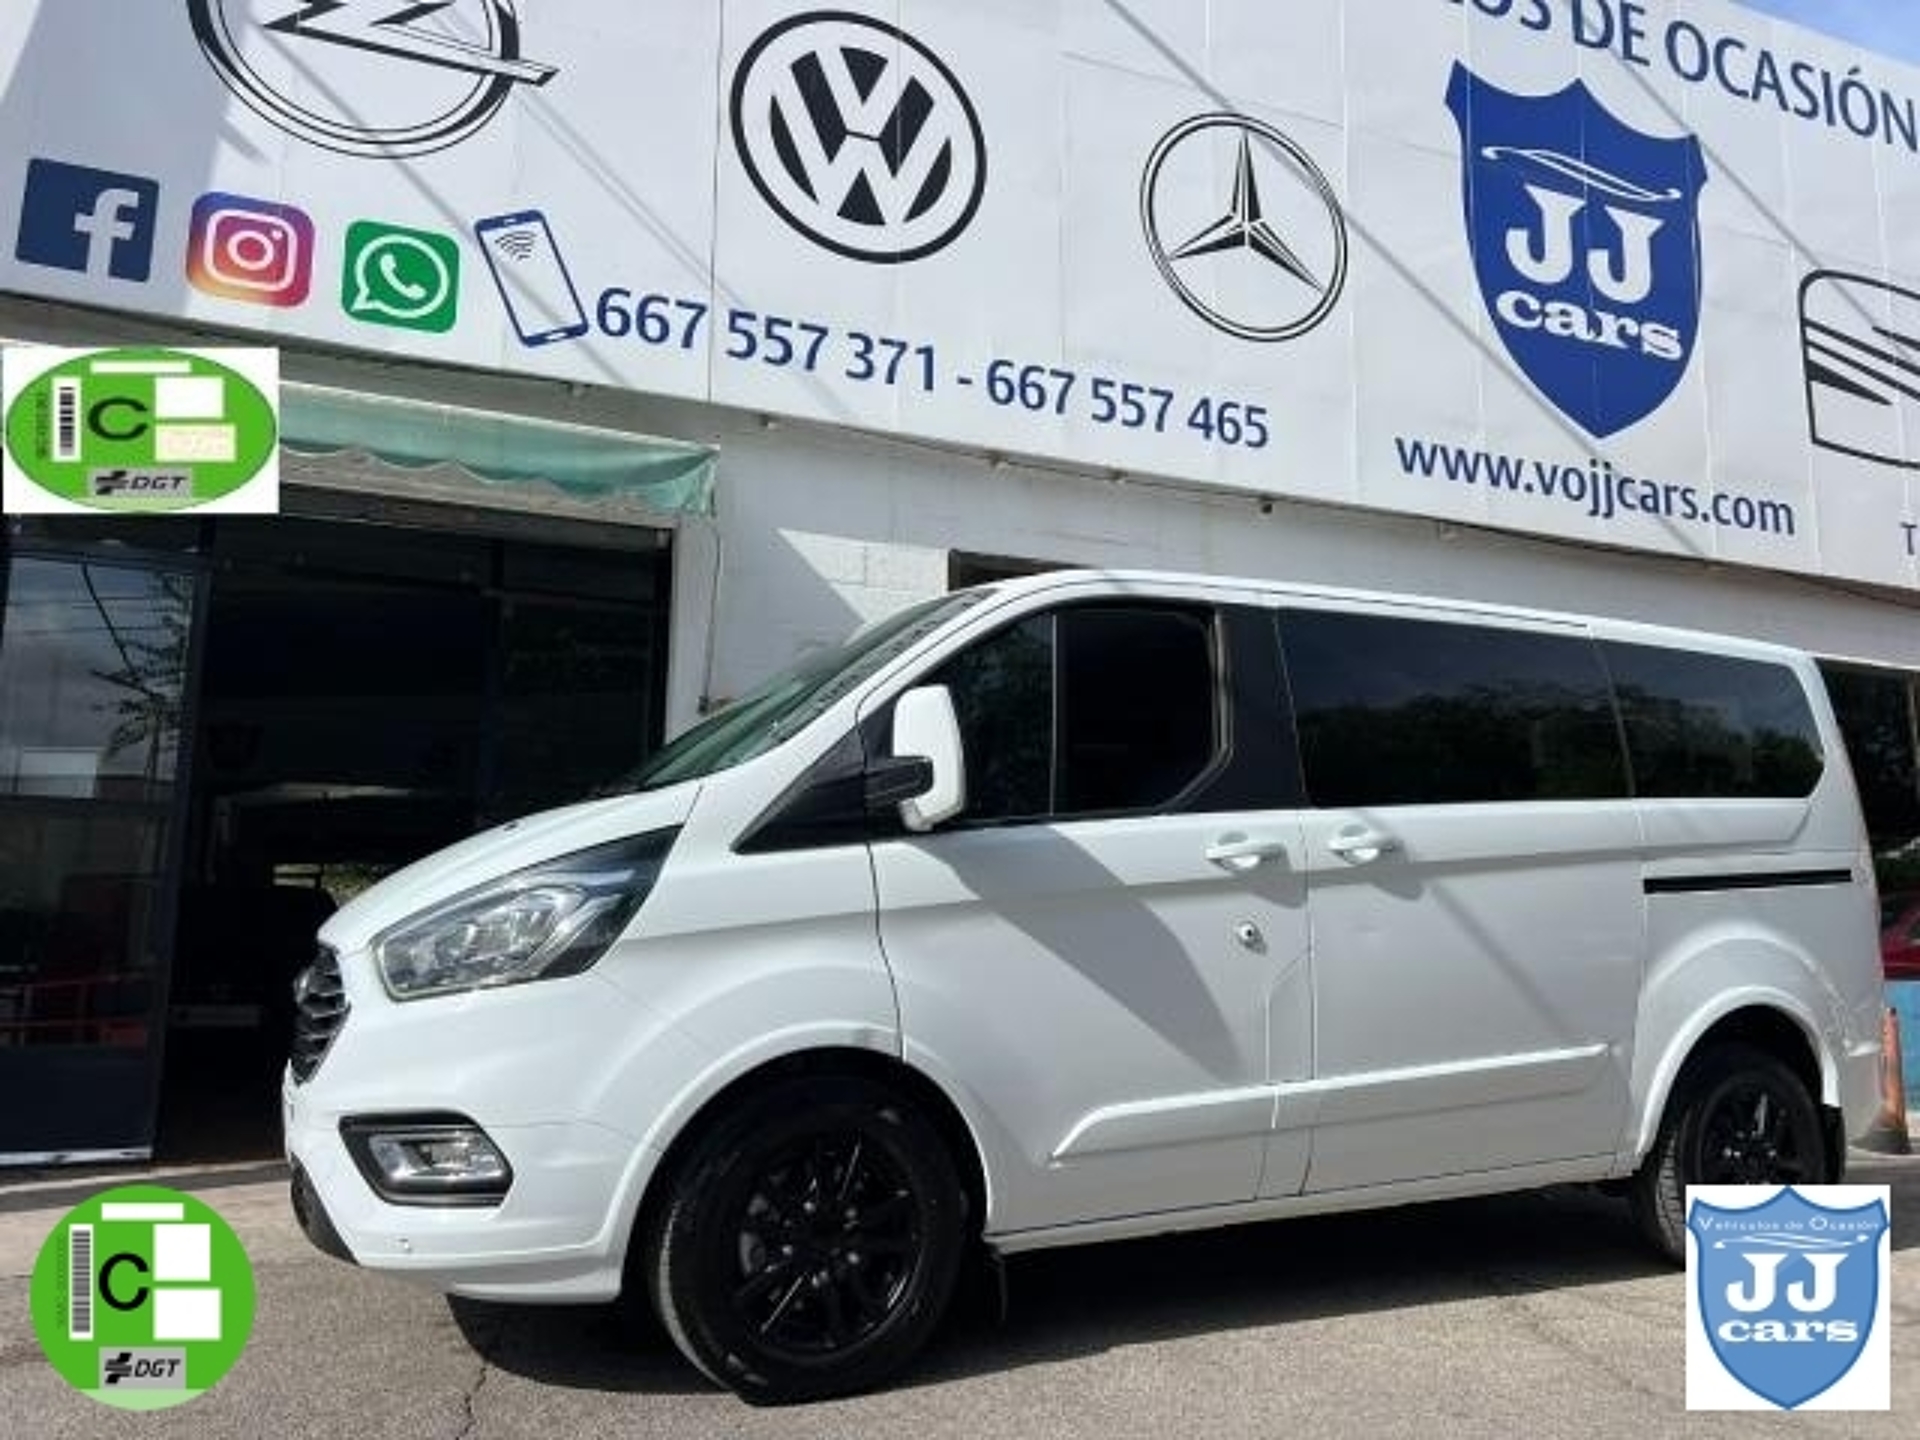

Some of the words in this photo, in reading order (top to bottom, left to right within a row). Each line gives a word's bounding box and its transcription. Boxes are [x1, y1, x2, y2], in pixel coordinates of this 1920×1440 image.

[1571, 0, 1650, 66] DE
[1665, 20, 1919, 152] OCASIÓN
[1505, 182, 1665, 303] JJ
[597, 287, 707, 348] 667
[726, 309, 829, 371] 557
[845, 332, 934, 391] 371
[986, 359, 1075, 414] 667
[1091, 377, 1174, 432] 557
[1187, 397, 1269, 448] 465
[1496, 290, 1683, 361] cars
[1395, 437, 1795, 535] www.vojjcars.com
